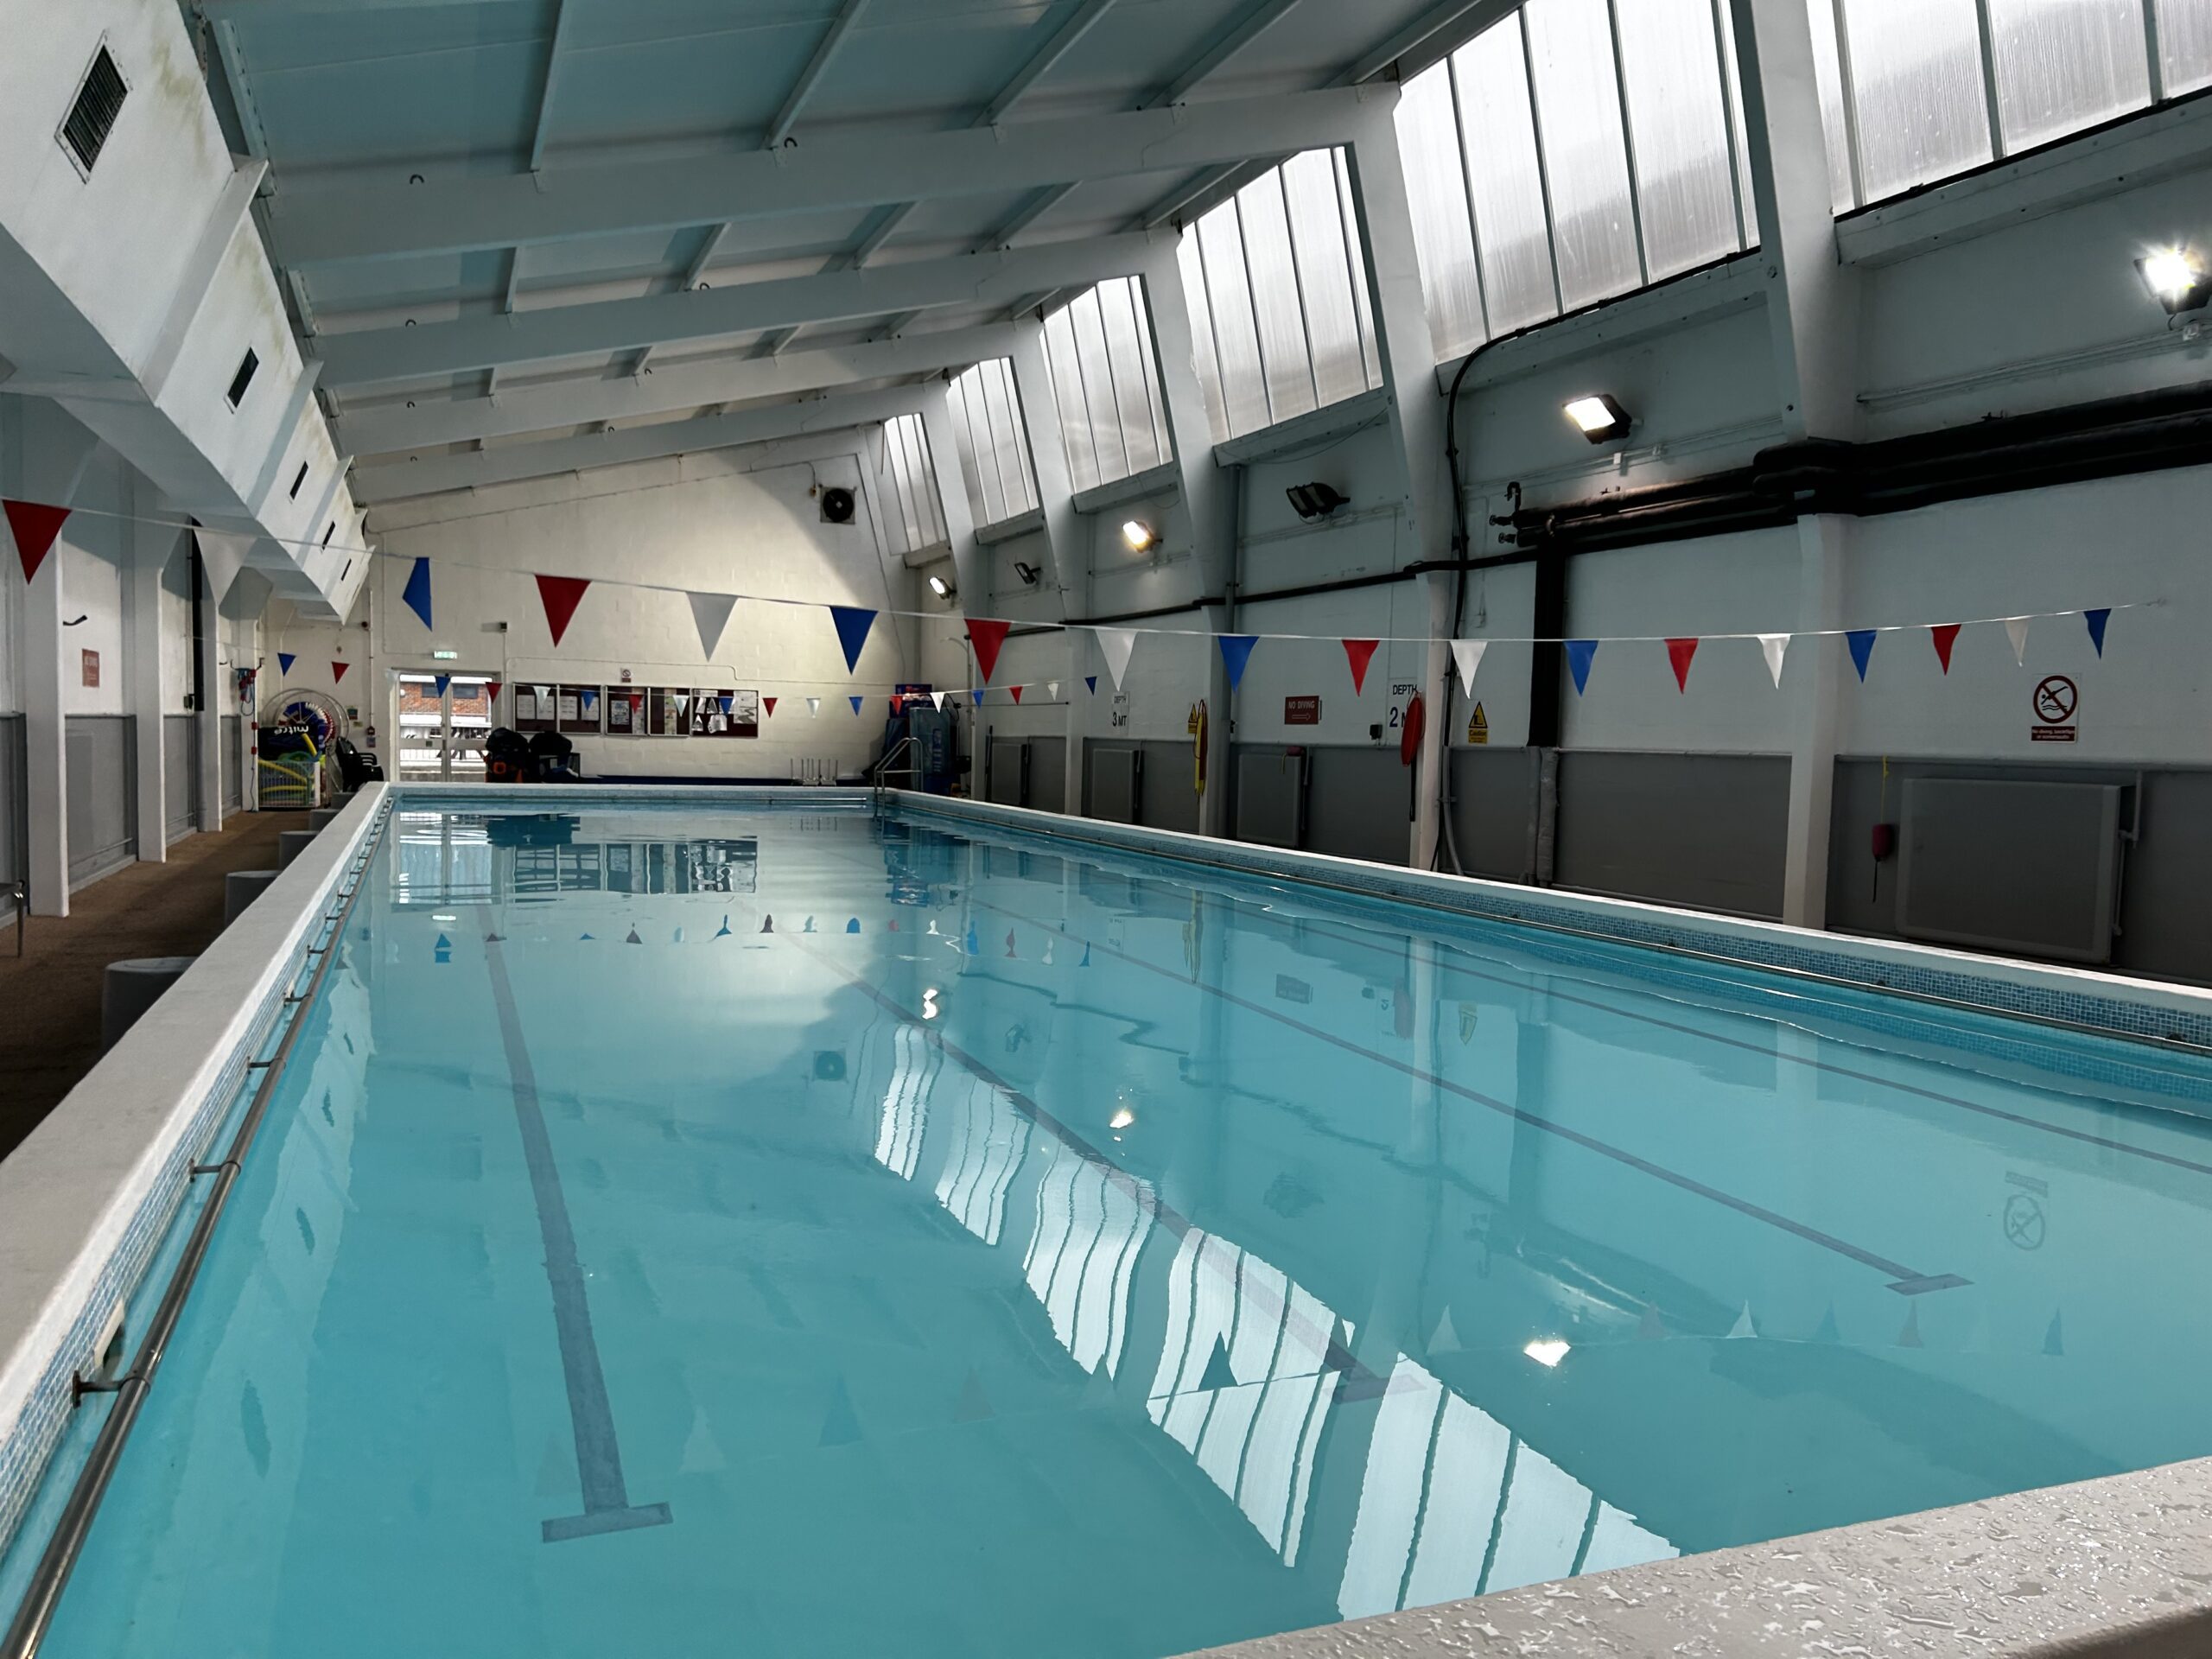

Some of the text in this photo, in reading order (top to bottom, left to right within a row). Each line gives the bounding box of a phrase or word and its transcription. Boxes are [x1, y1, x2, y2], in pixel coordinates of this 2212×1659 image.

[1392, 684, 1417, 695] DEPTH
[1288, 701, 1314, 709] NO DIVING
[1112, 711, 1127, 727] 3 MT
[1389, 706, 1398, 728] 2
[274, 726, 309, 735] mitre
